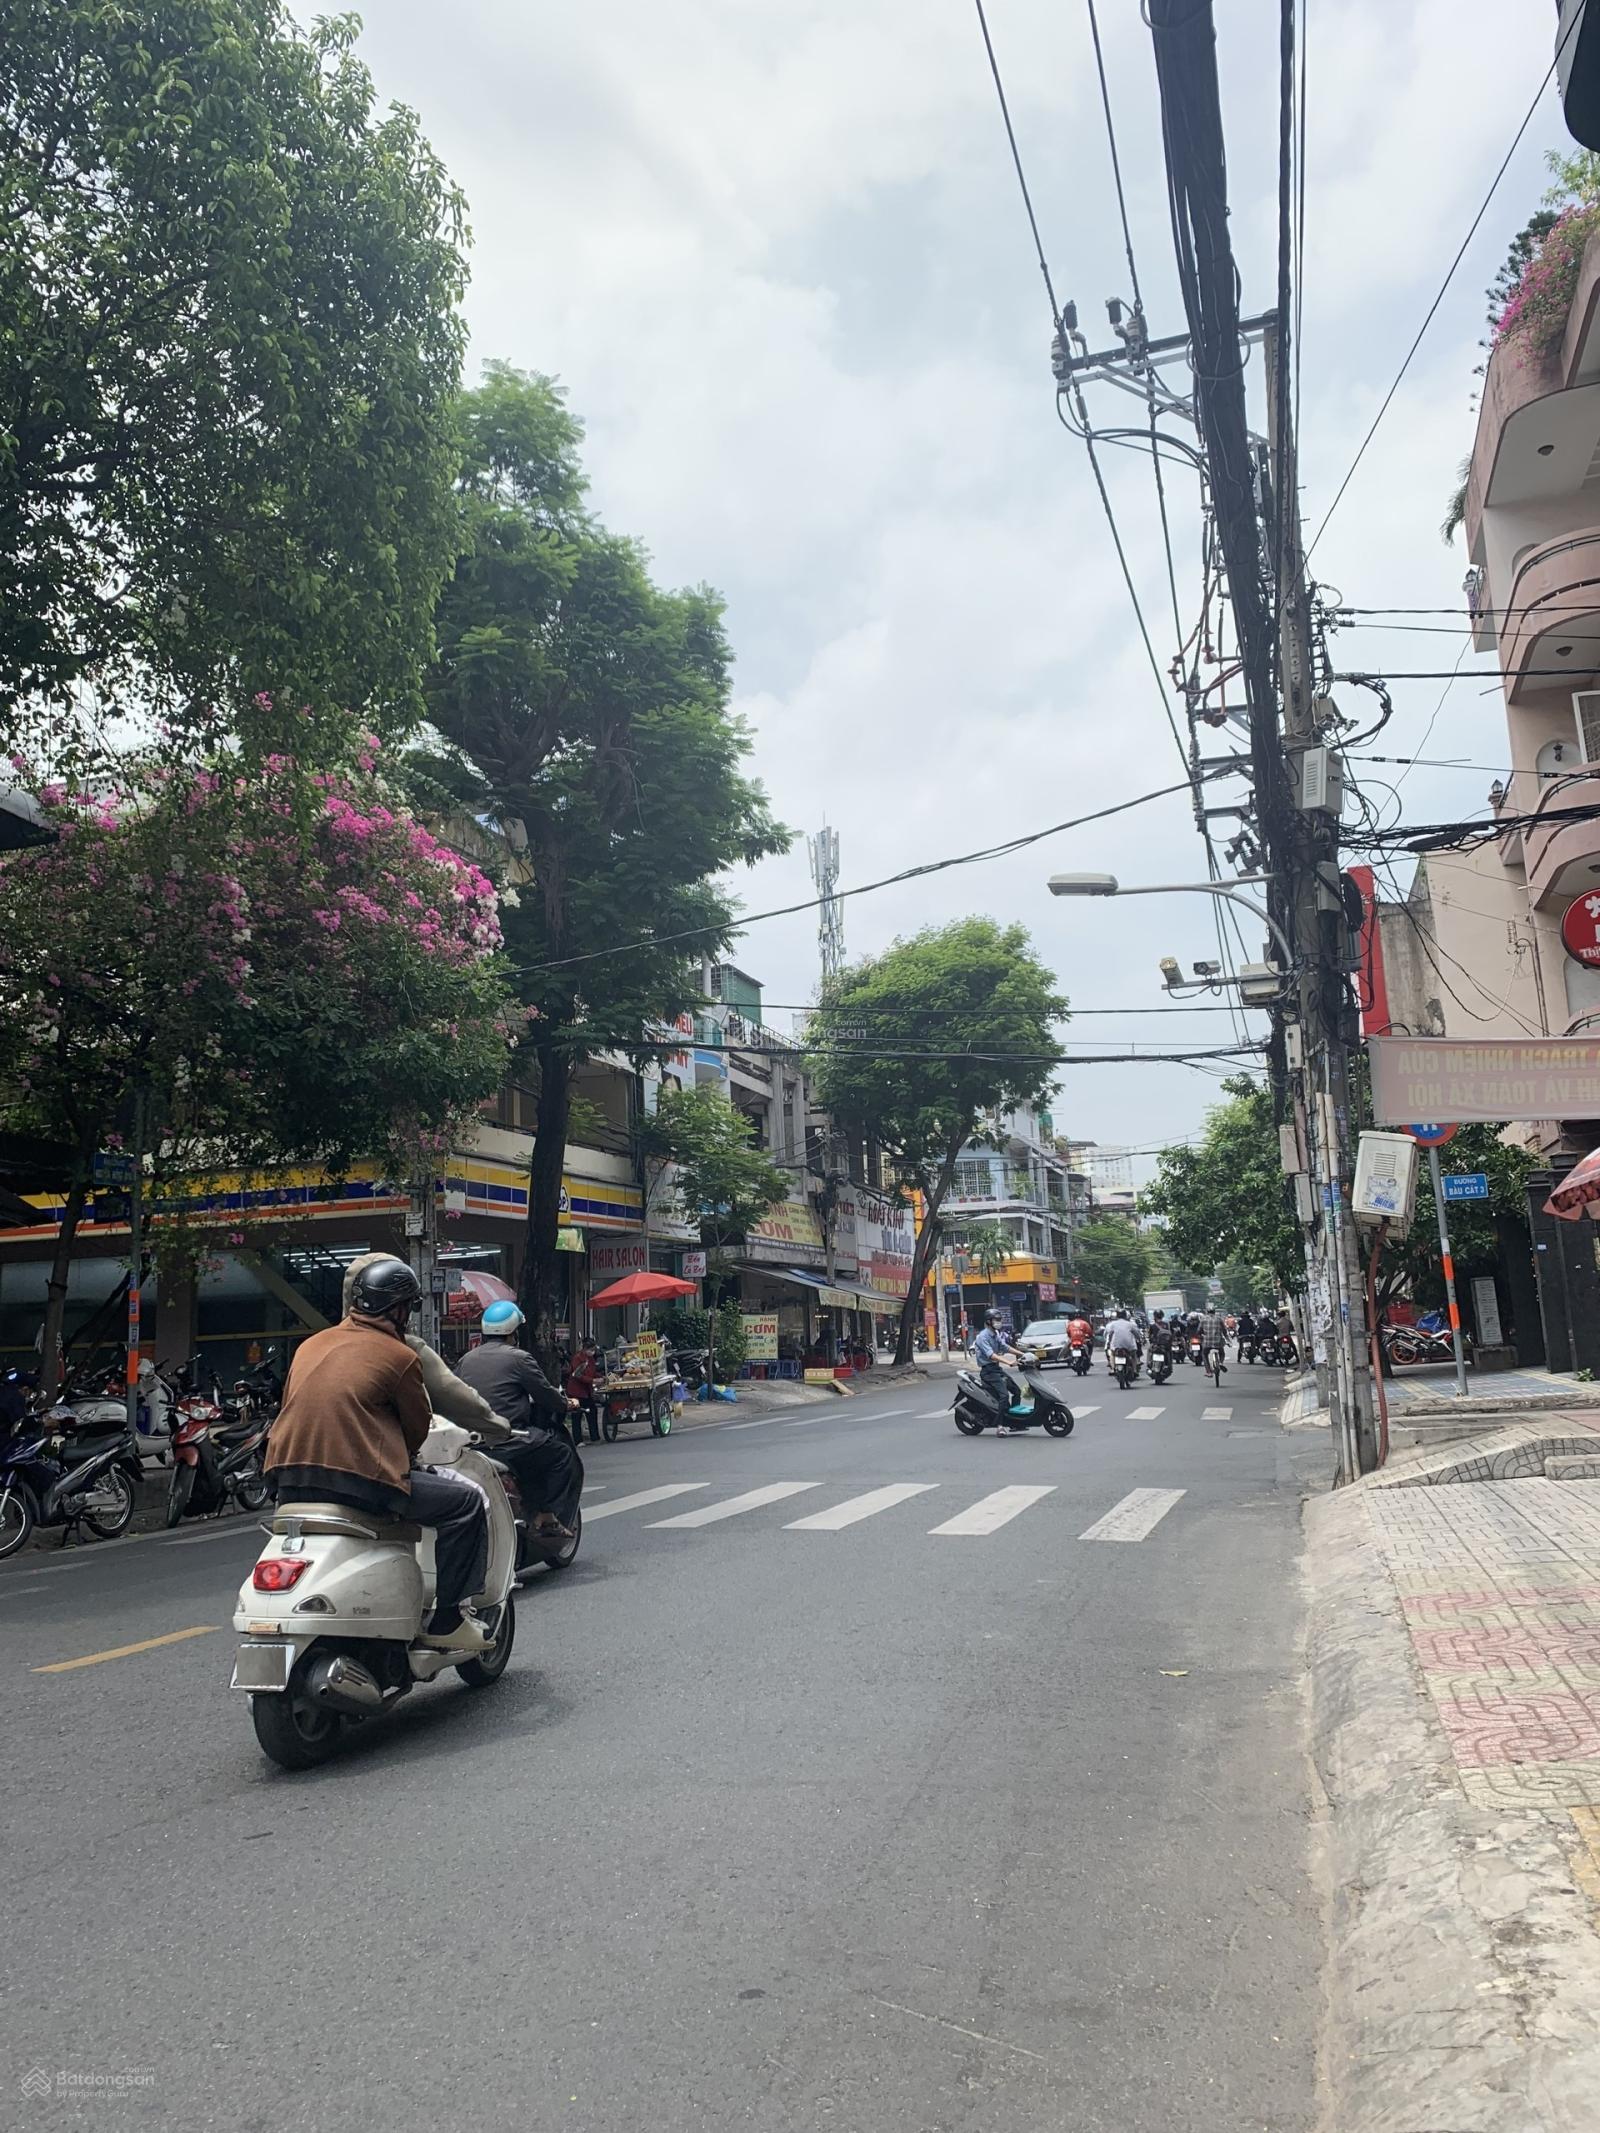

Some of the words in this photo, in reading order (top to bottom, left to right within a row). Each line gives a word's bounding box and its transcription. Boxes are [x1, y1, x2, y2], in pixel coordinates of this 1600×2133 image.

[592, 1247, 614, 1270] HAIR
[616, 1246, 645, 1268] SALON
[744, 1323, 776, 1334] CƠM
